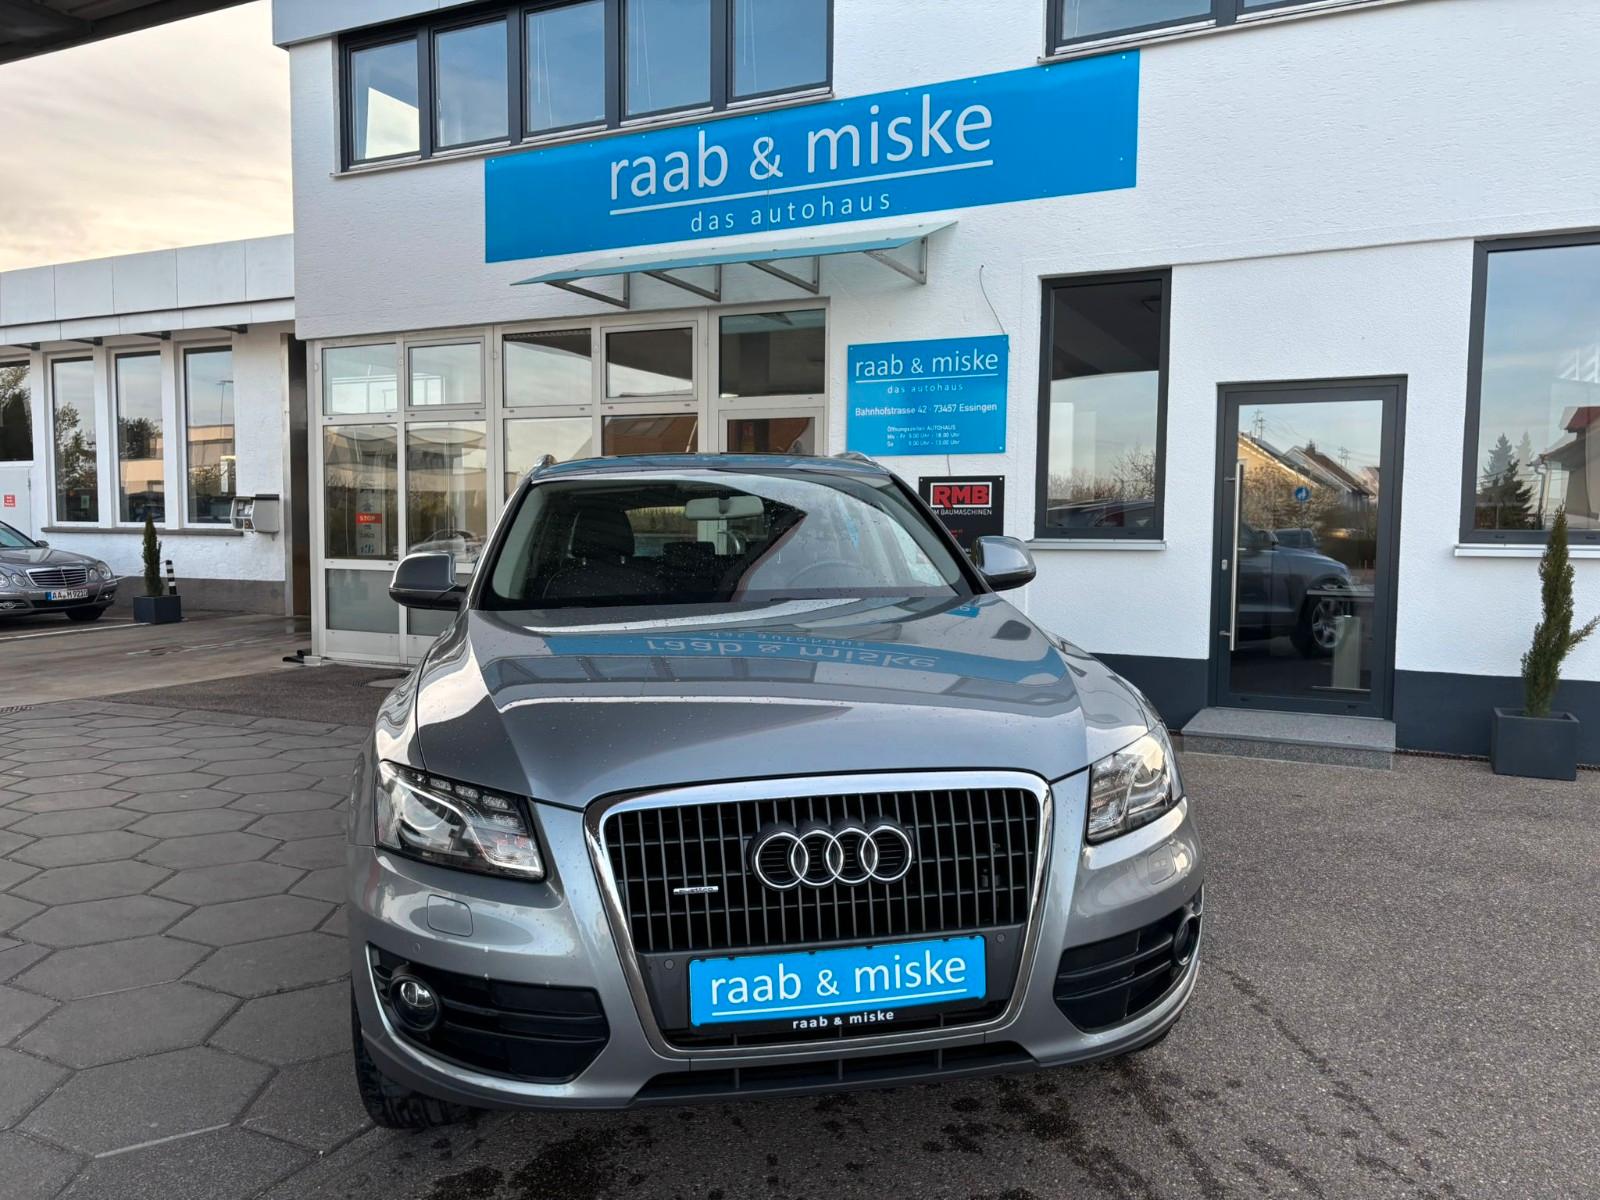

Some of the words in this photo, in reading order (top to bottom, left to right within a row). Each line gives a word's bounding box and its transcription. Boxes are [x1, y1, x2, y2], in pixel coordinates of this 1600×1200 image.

[609, 130, 728, 200] raab
[749, 135, 784, 180] &
[807, 93, 993, 172] miske
[690, 211, 735, 233] das
[750, 192, 891, 224] autohaus
[855, 354, 903, 377] raab
[911, 357, 924, 374] &
[932, 348, 999, 373] miske
[887, 385, 905, 394] das
[911, 383, 963, 393] autohaus
[855, 407, 915, 417] Bahnhofstrasse
[917, 405, 927, 414] 42
[959, 402, 997, 414] Essingen
[933, 486, 989, 508] RMB
[941, 508, 992, 516] BAUMASCHINEN
[711, 962, 802, 1006] raab
[816, 969, 840, 997] &
[854, 949, 967, 993] miske
[792, 1016, 828, 1030] raab
[833, 1016, 843, 1026] &
[849, 1009, 895, 1024] miske
